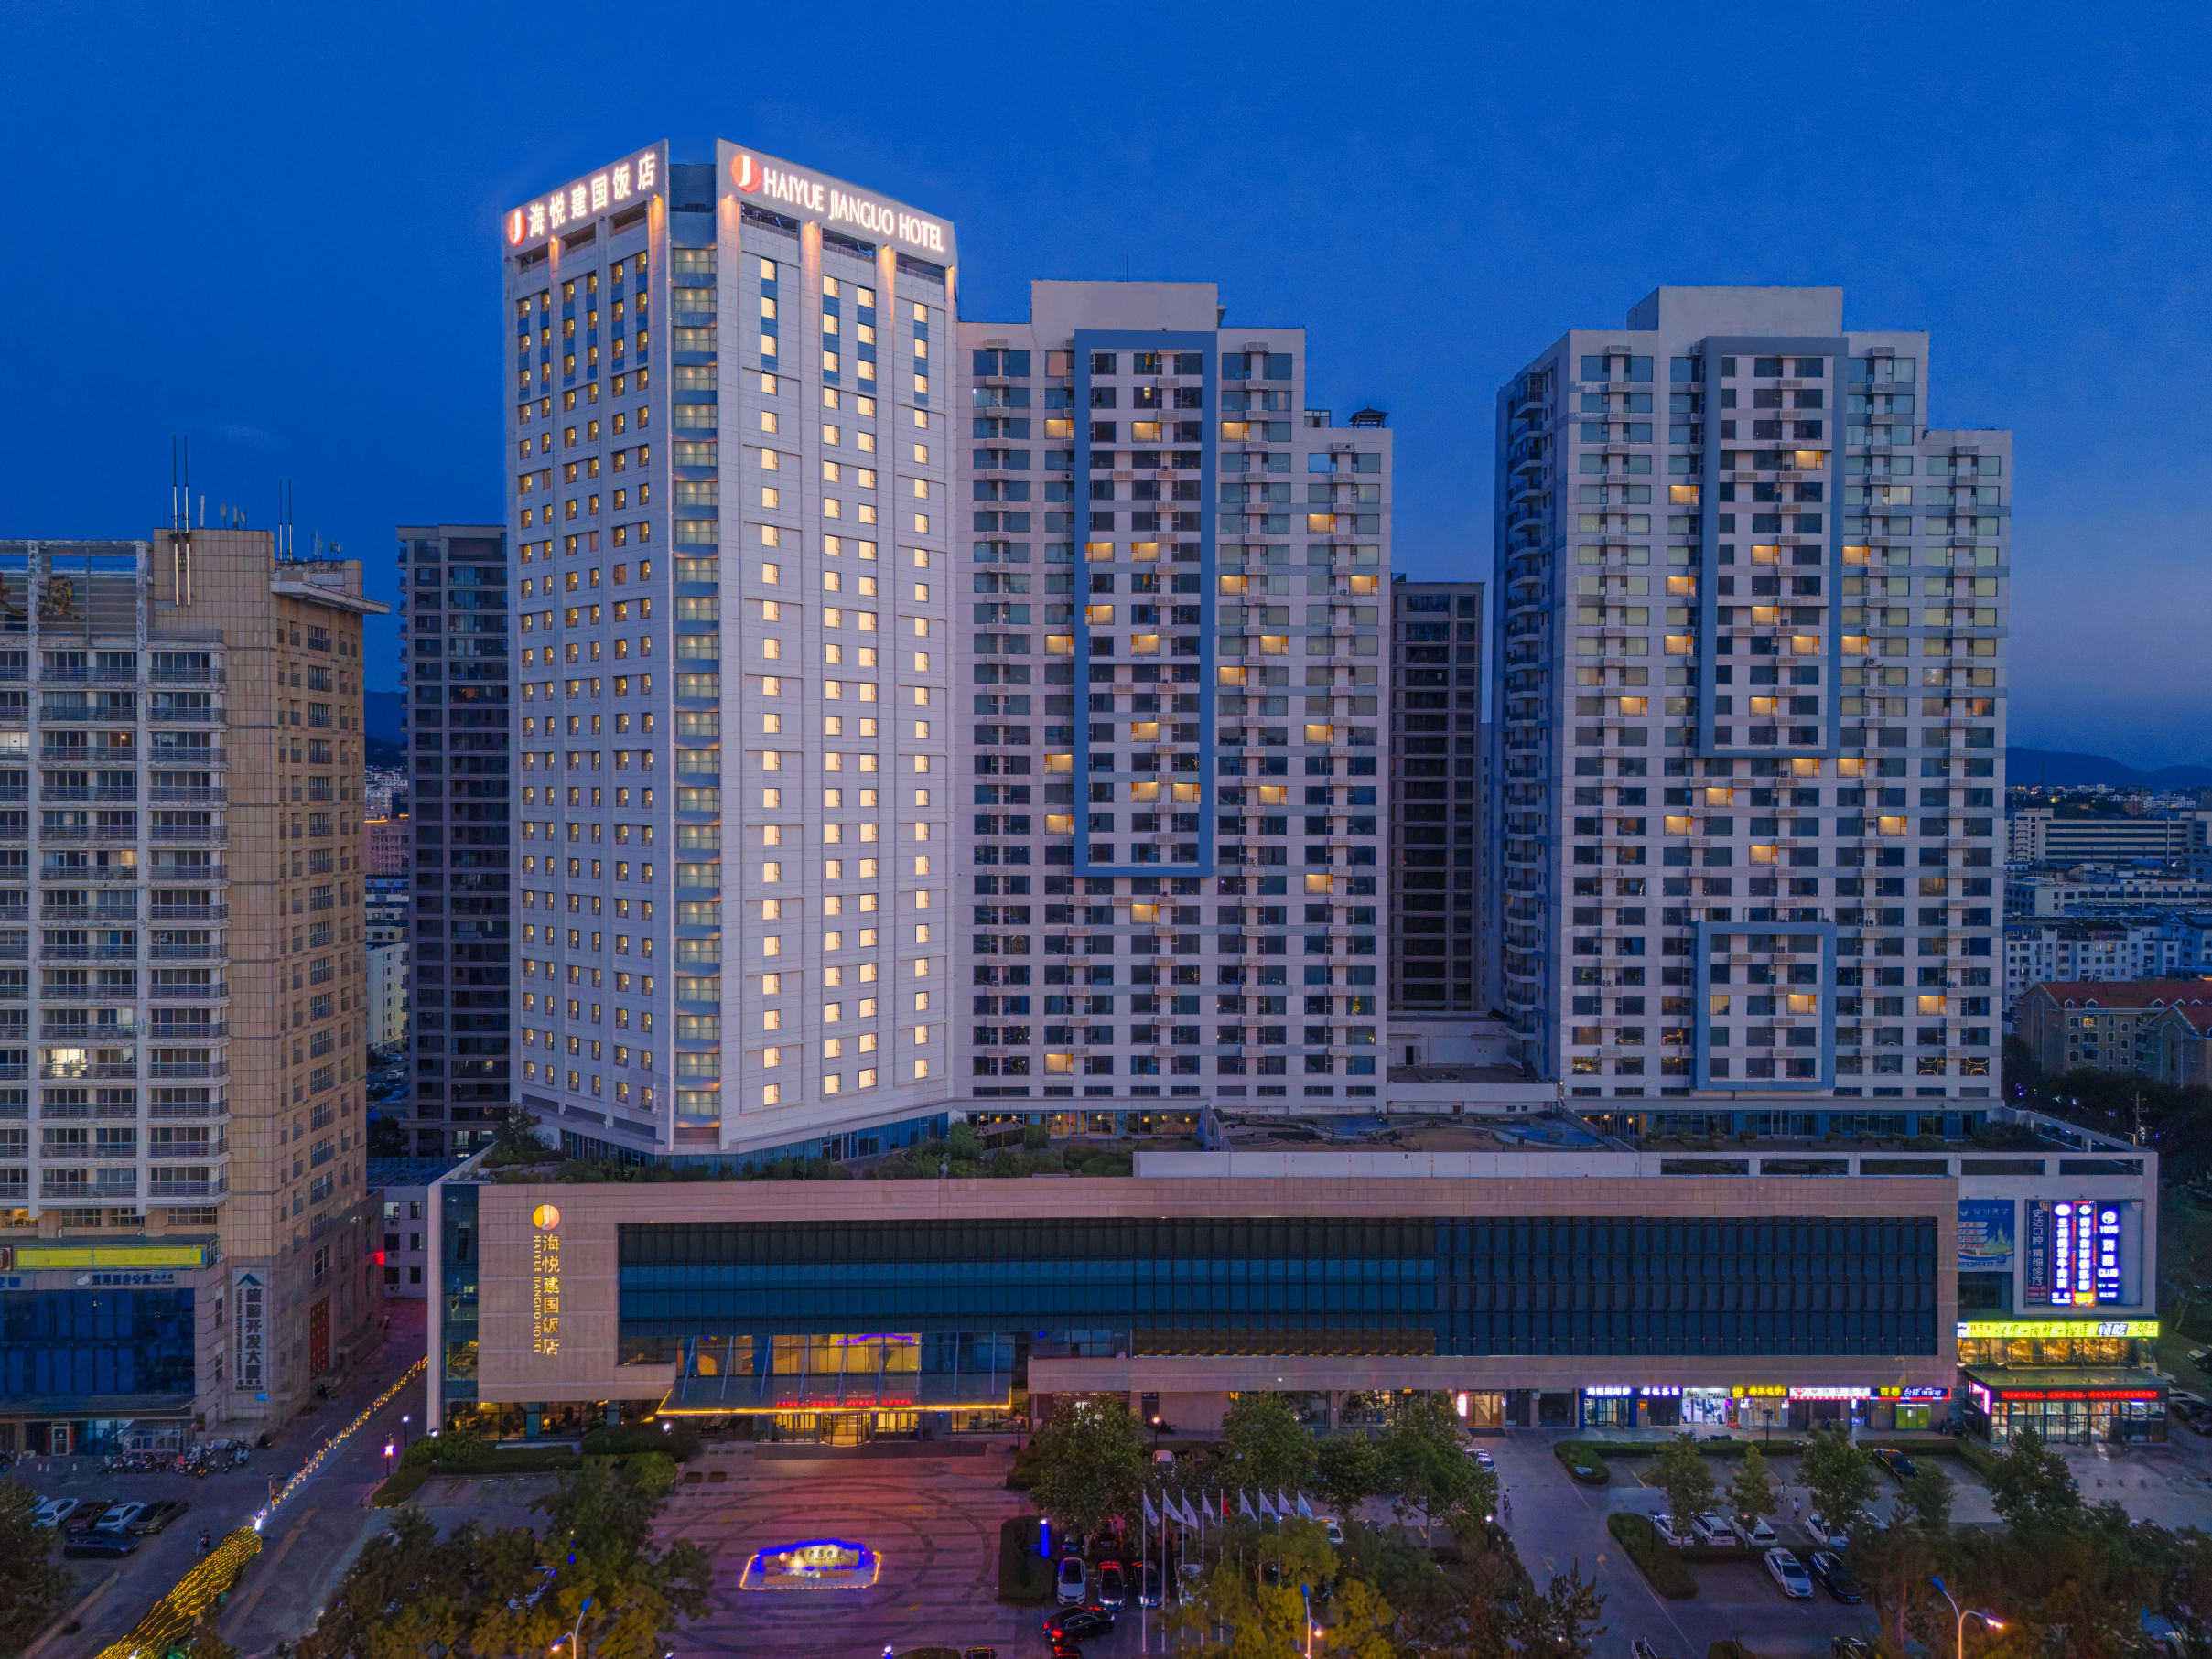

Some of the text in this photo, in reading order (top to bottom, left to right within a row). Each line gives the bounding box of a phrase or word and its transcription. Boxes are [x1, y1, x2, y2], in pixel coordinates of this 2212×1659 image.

[529, 152, 655, 237] 海悦建国饭店
[762, 167, 944, 252] HAIYUE JIANGUO HOTEL
[2032, 1208, 2044, 1245] 史达口腔
[2032, 1249, 2044, 1286] 精细诊疗
[533, 1235, 542, 1352] HAIYUE JIANGUO HOTEL
[542, 1234, 560, 1356] 海悦建国饭店
